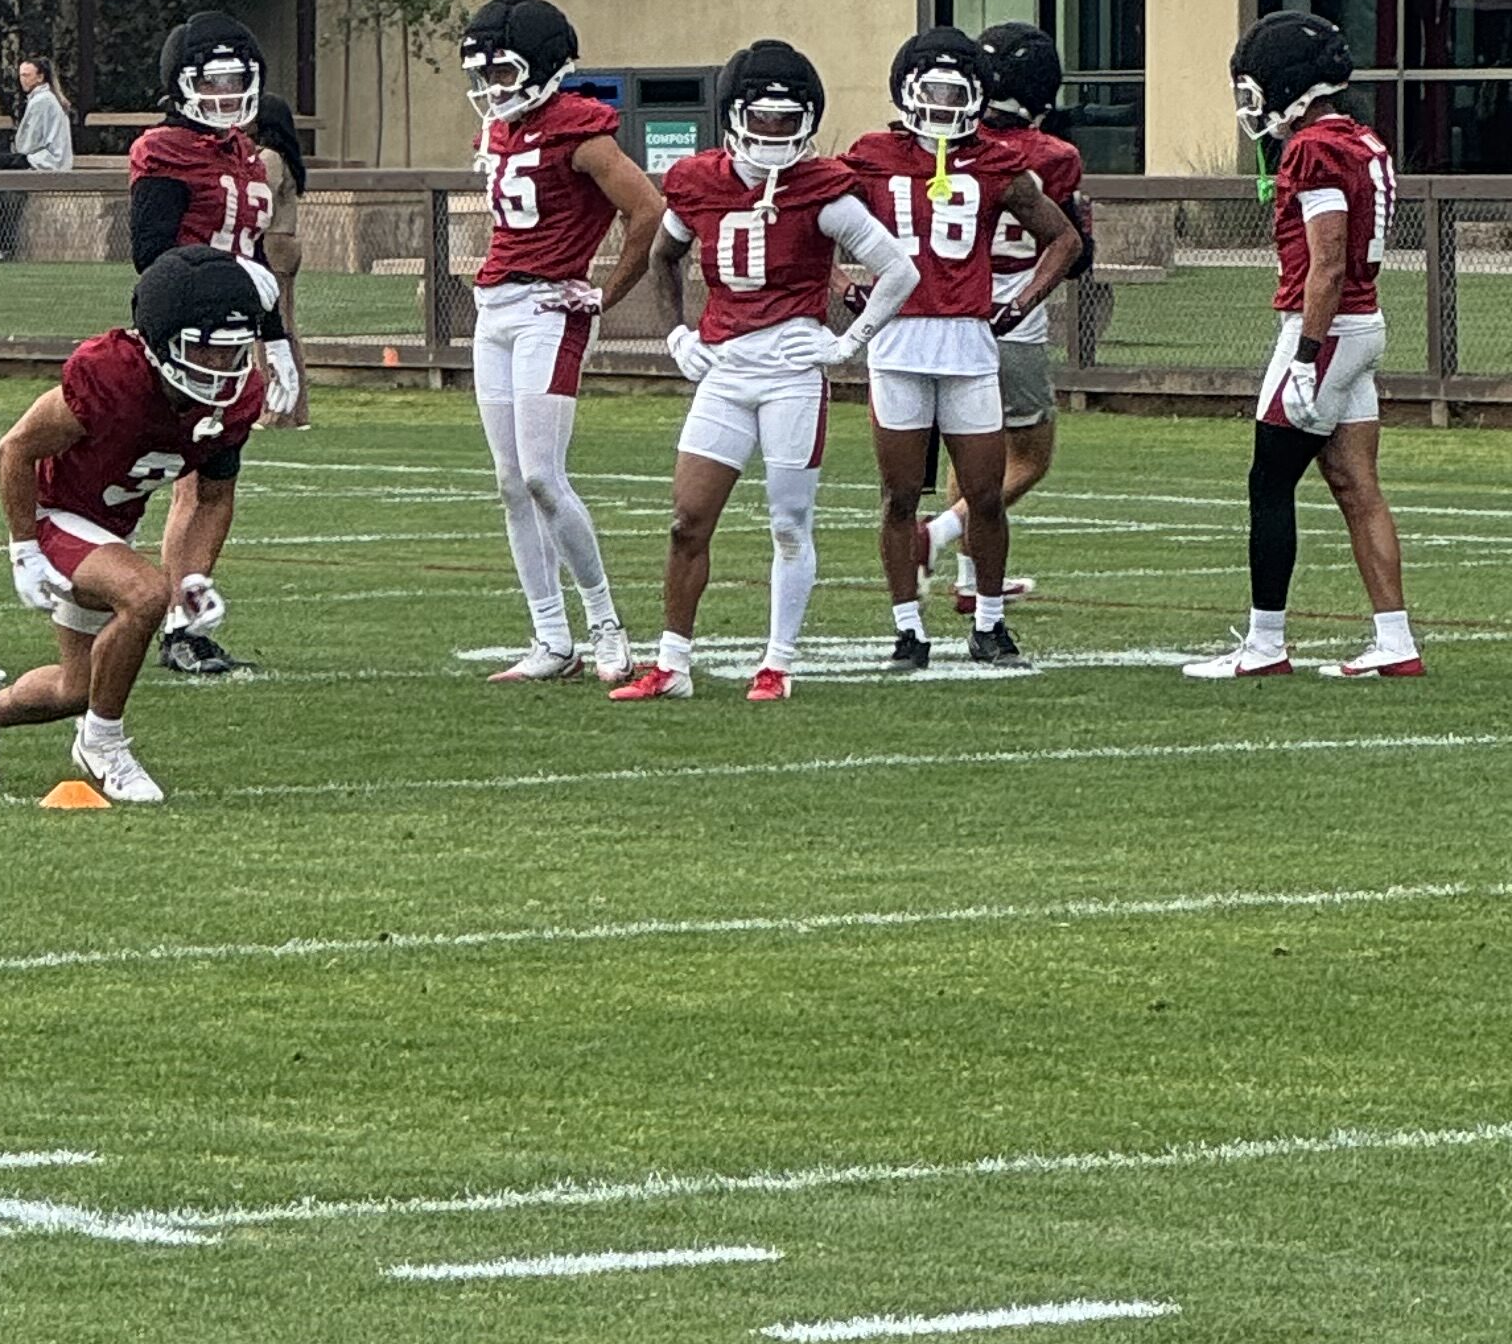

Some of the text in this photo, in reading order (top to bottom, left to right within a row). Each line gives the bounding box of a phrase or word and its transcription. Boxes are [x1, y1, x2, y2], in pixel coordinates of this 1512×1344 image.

[646, 133, 697, 145] COMPOST
[210, 174, 273, 258] 13
[717, 211, 767, 292] 0
[888, 173, 980, 259] 18
